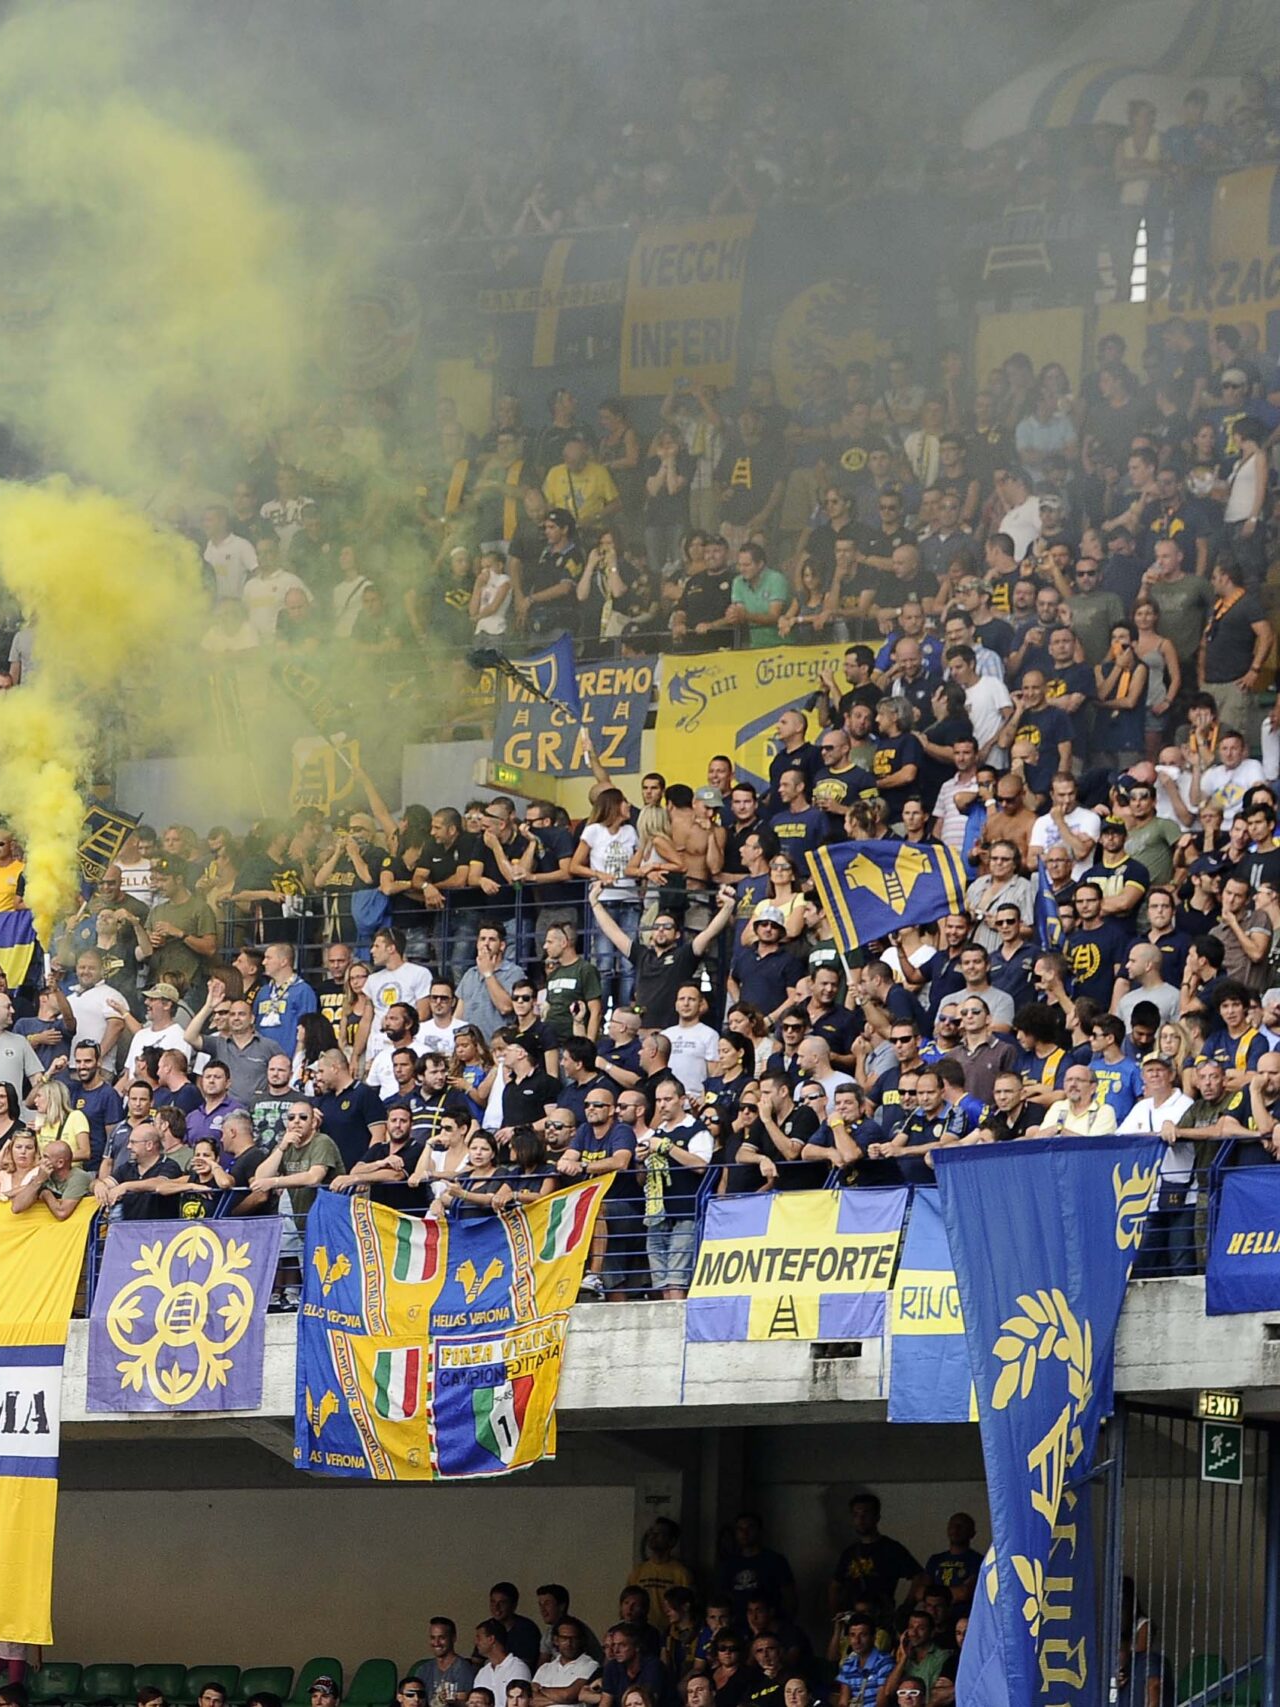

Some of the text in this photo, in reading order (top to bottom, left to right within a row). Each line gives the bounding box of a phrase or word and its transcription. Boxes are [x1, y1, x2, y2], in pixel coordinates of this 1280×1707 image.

[504, 725, 628, 772] GRAZ
[119, 876, 154, 888] ELLA
[506, 1209, 528, 1259] AMPIONE
[1227, 1230, 1280, 1255] HELL
[697, 1243, 895, 1286] MONTEFORTE
[432, 1306, 510, 1327] HELLAS VERONA
[1206, 1395, 1241, 1417] EXIT
[497, 1414, 513, 1448] 1
[325, 1451, 366, 1469] VERONA
